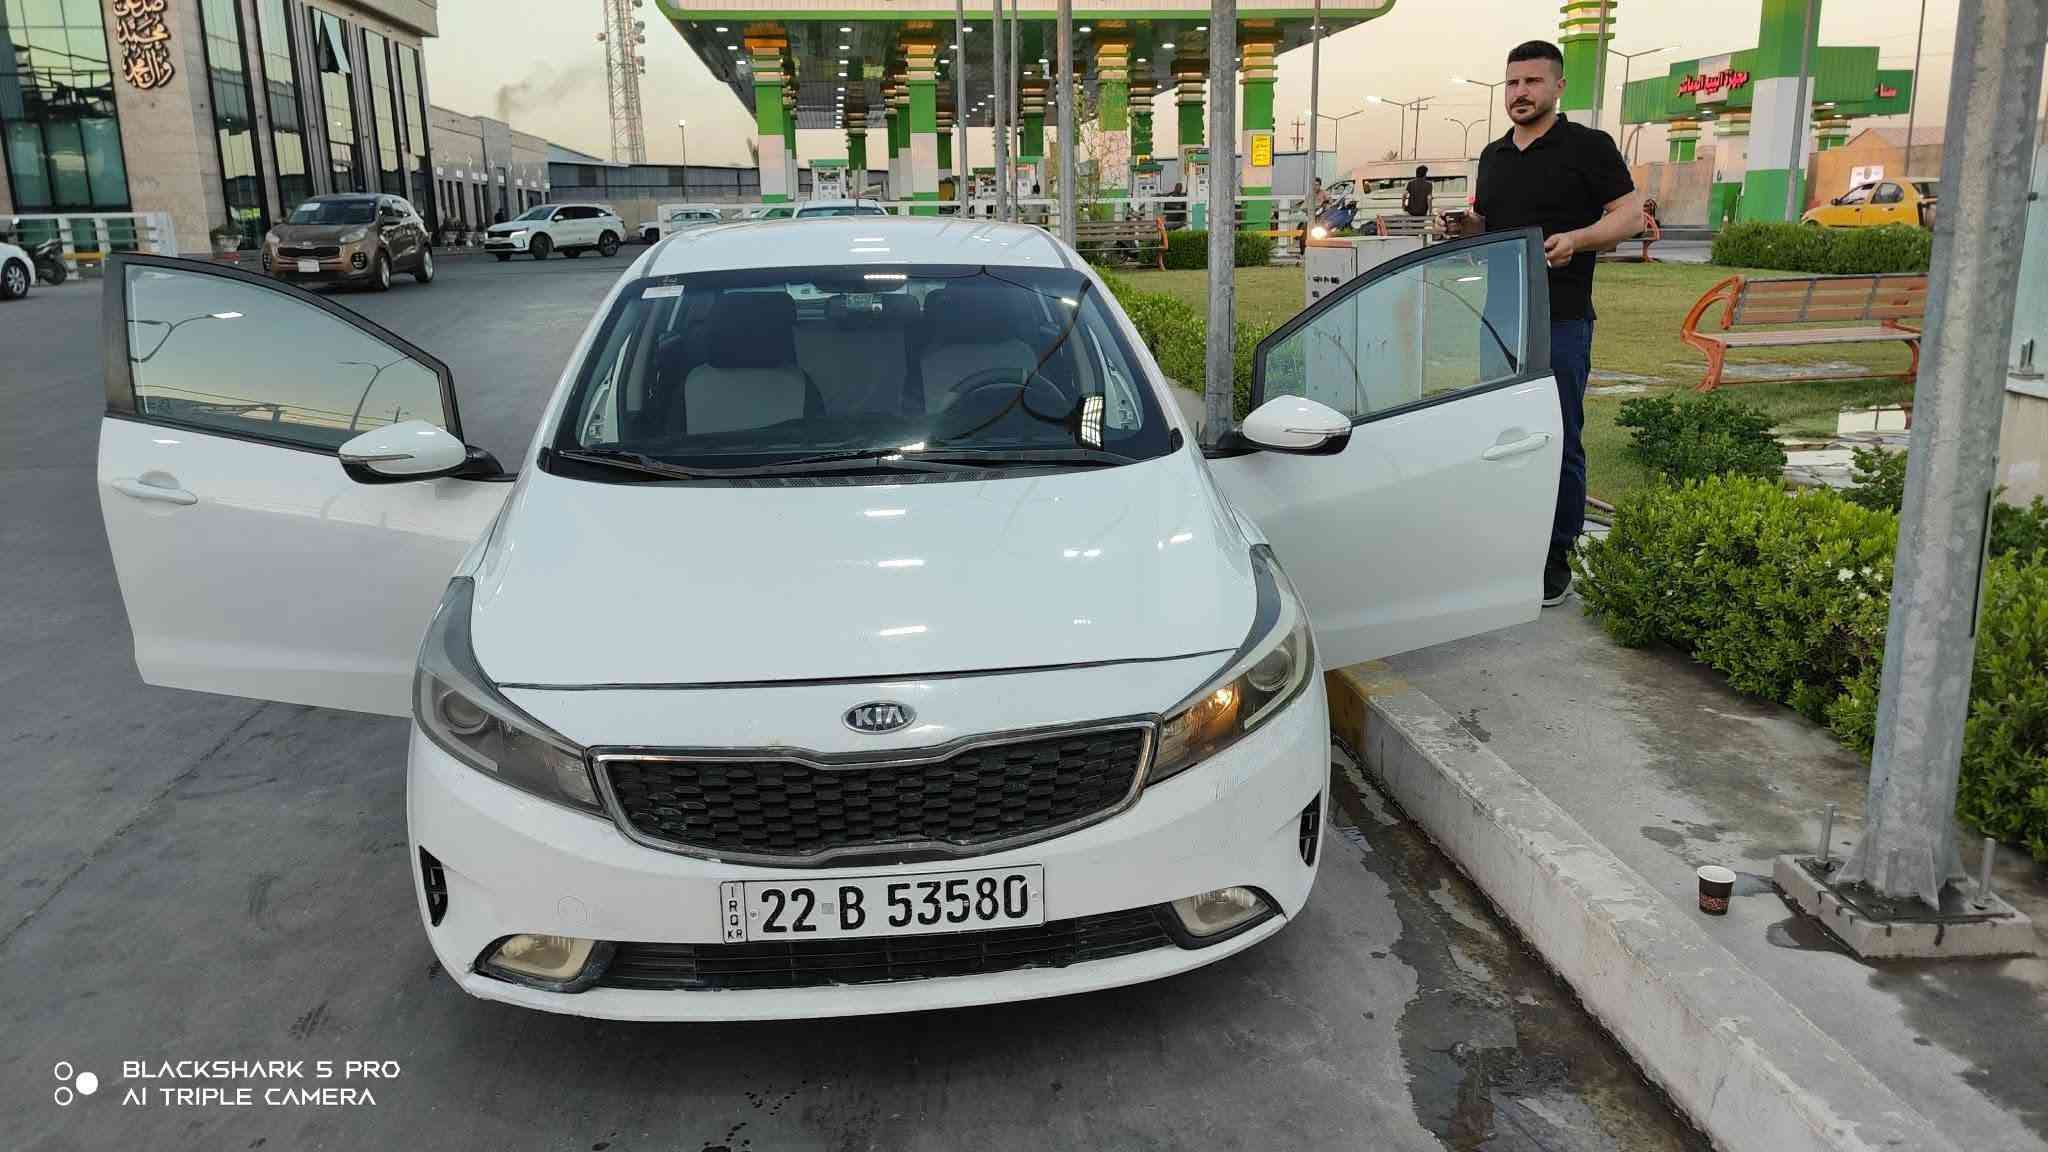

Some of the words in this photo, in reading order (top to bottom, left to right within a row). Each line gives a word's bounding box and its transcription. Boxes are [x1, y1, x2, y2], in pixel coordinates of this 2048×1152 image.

[855, 706, 904, 728] KIA
[760, 888, 817, 933] 22
[838, 886, 866, 930] B
[887, 874, 1028, 928] 53580
